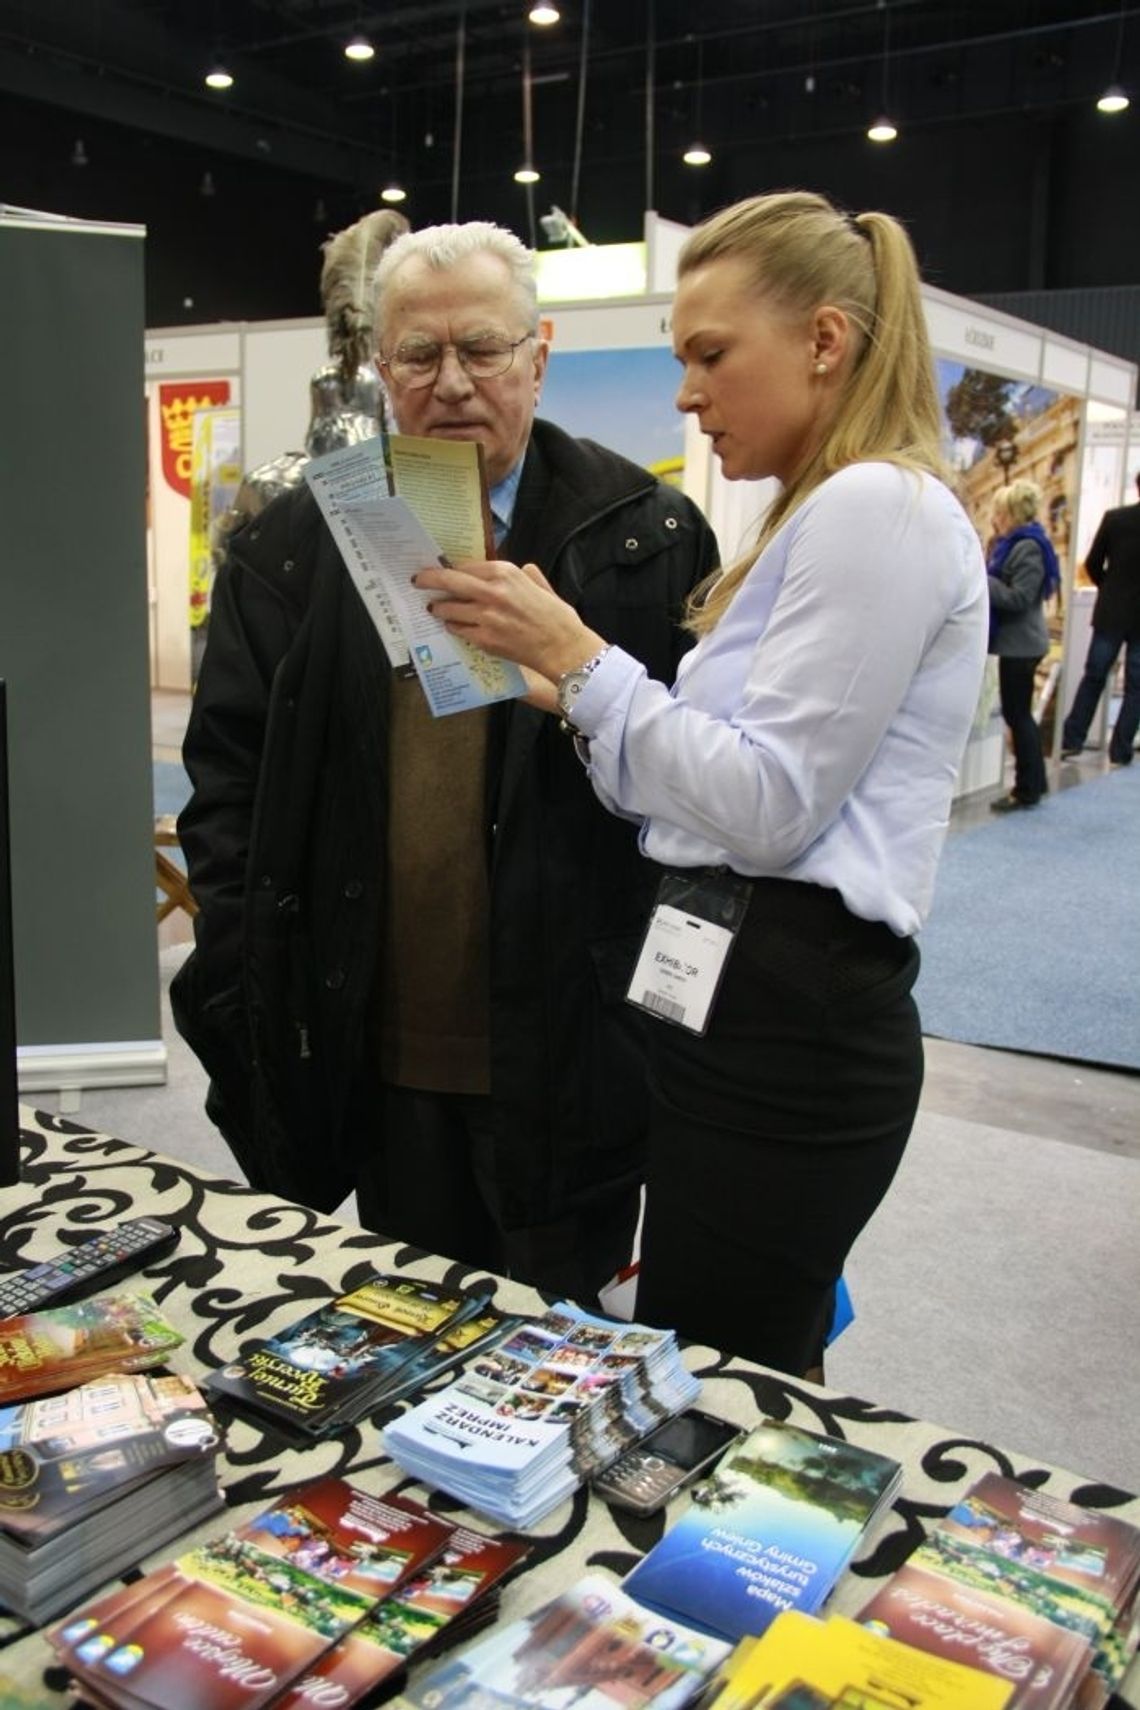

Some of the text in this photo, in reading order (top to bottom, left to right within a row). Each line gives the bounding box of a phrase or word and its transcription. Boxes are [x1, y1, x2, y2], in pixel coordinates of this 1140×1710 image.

[434, 1411, 539, 1446] KALENDARZ
[444, 1403, 511, 1431] IMPREZ
[701, 1538, 809, 1587] turystycznych
[710, 1528, 817, 1574] Gminy Gniew
[735, 1566, 801, 1597] szlaków
[746, 1584, 793, 1609] Mapa
[889, 1587, 1005, 1641] miracles
[909, 1609, 984, 1646] place
[976, 1641, 1034, 1679] The
